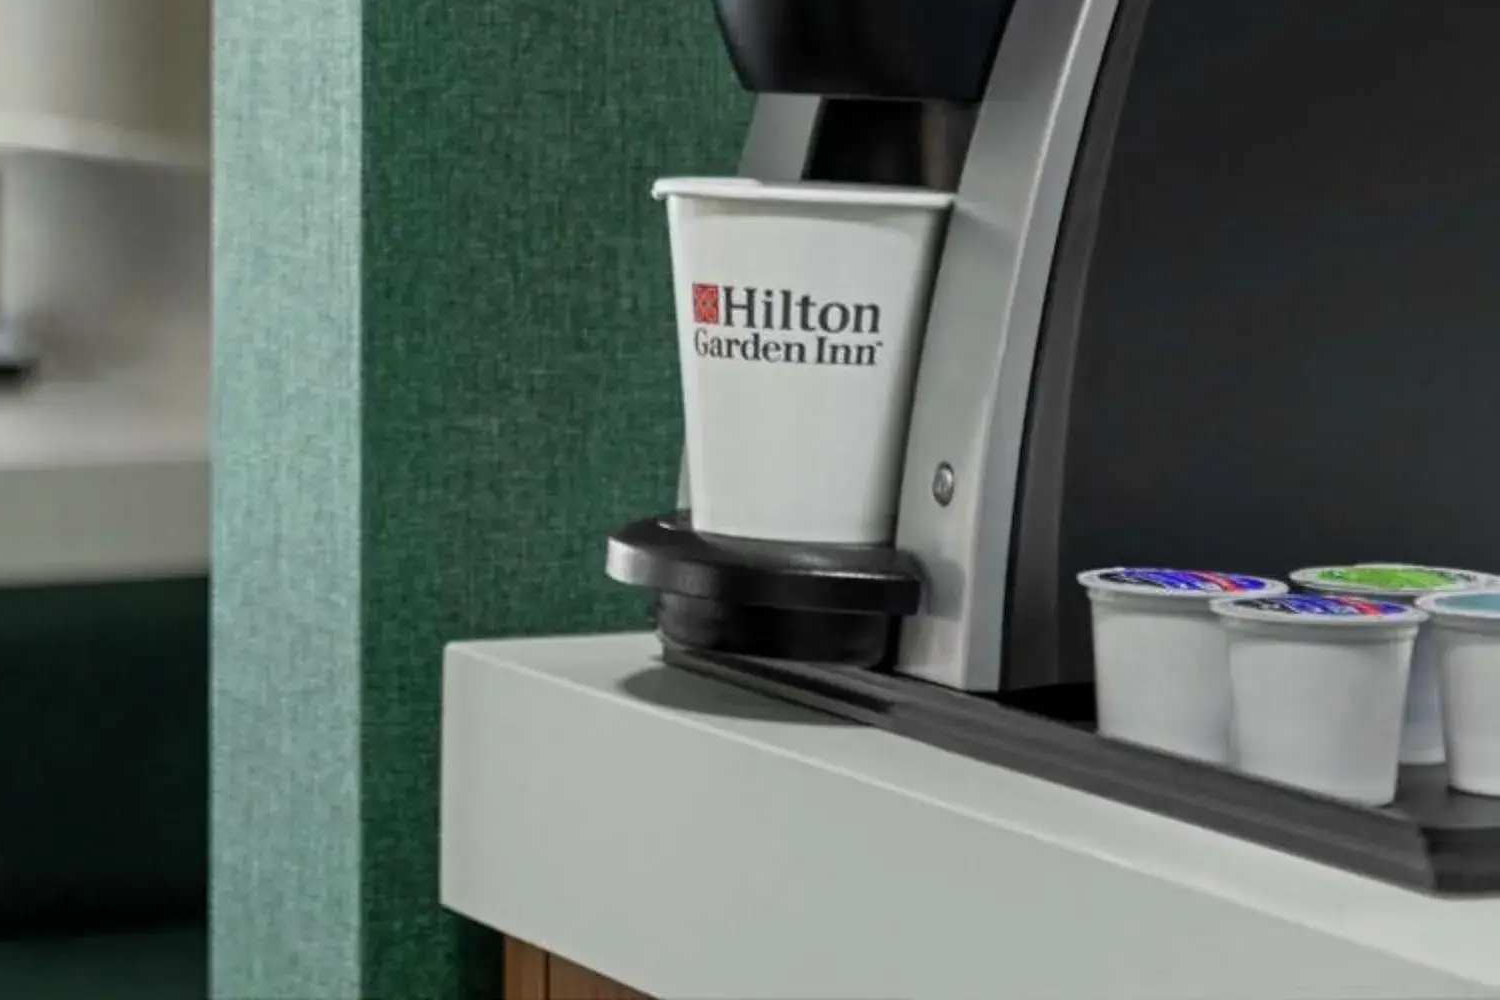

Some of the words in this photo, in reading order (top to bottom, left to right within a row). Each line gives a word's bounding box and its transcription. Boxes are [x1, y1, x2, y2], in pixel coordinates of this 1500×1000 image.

[723, 286, 880, 333] Hilton
[694, 327, 807, 363] Garden
[815, 336, 878, 366] Inn
